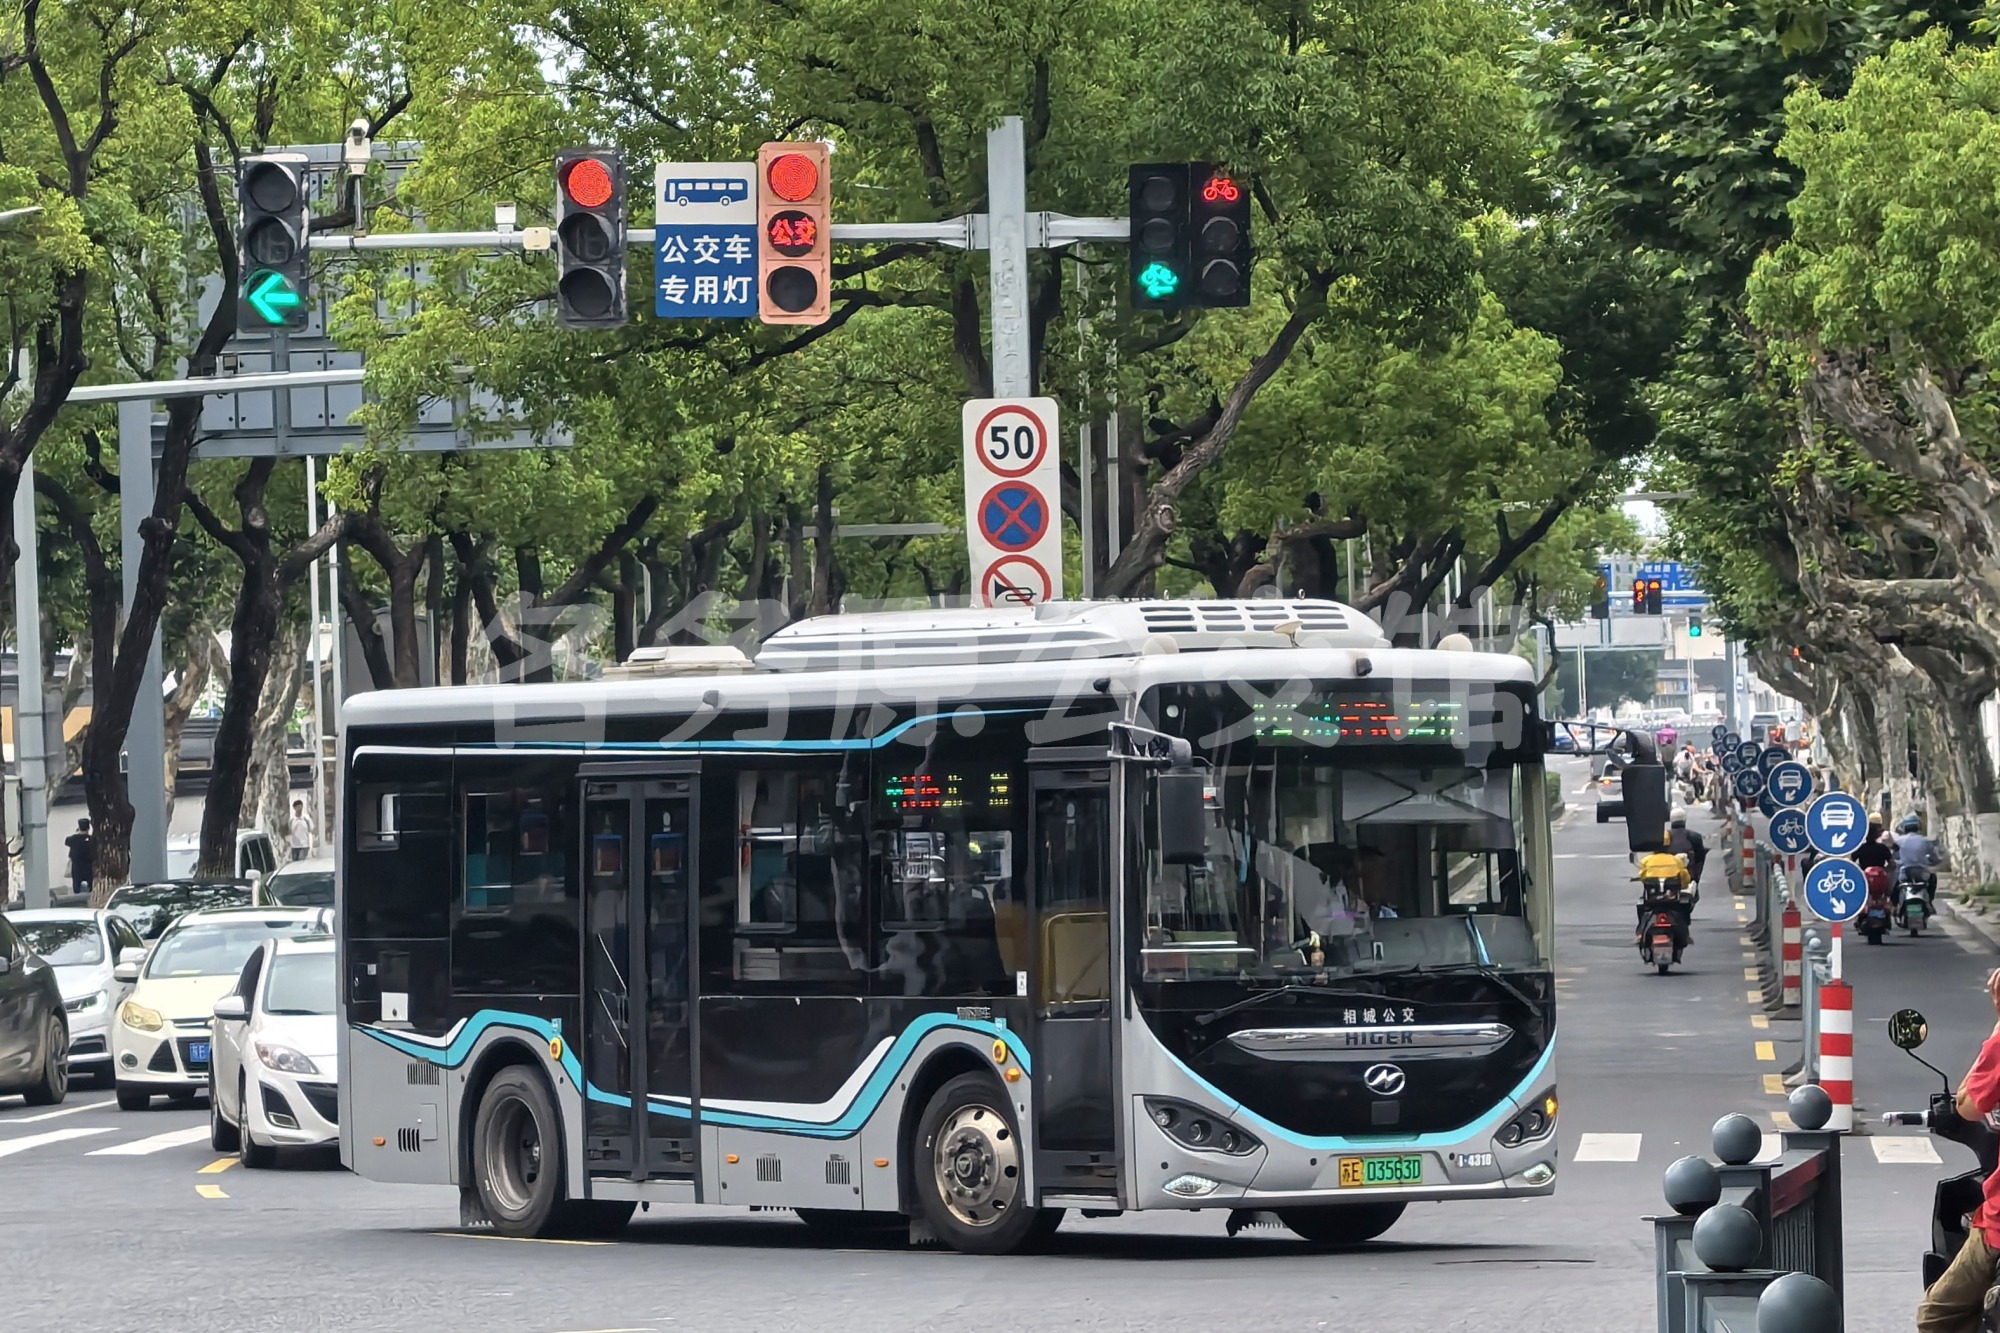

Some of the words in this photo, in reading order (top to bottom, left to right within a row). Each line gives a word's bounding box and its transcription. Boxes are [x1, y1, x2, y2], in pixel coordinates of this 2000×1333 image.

[770, 217, 816, 246] 公交
[660, 234, 752, 264] 公交车
[659, 275, 752, 304] 专用灯
[990, 425, 1035, 460] 50
[1343, 1007, 1415, 1024] 相城公交
[1345, 1031, 1413, 1046] HIGER
